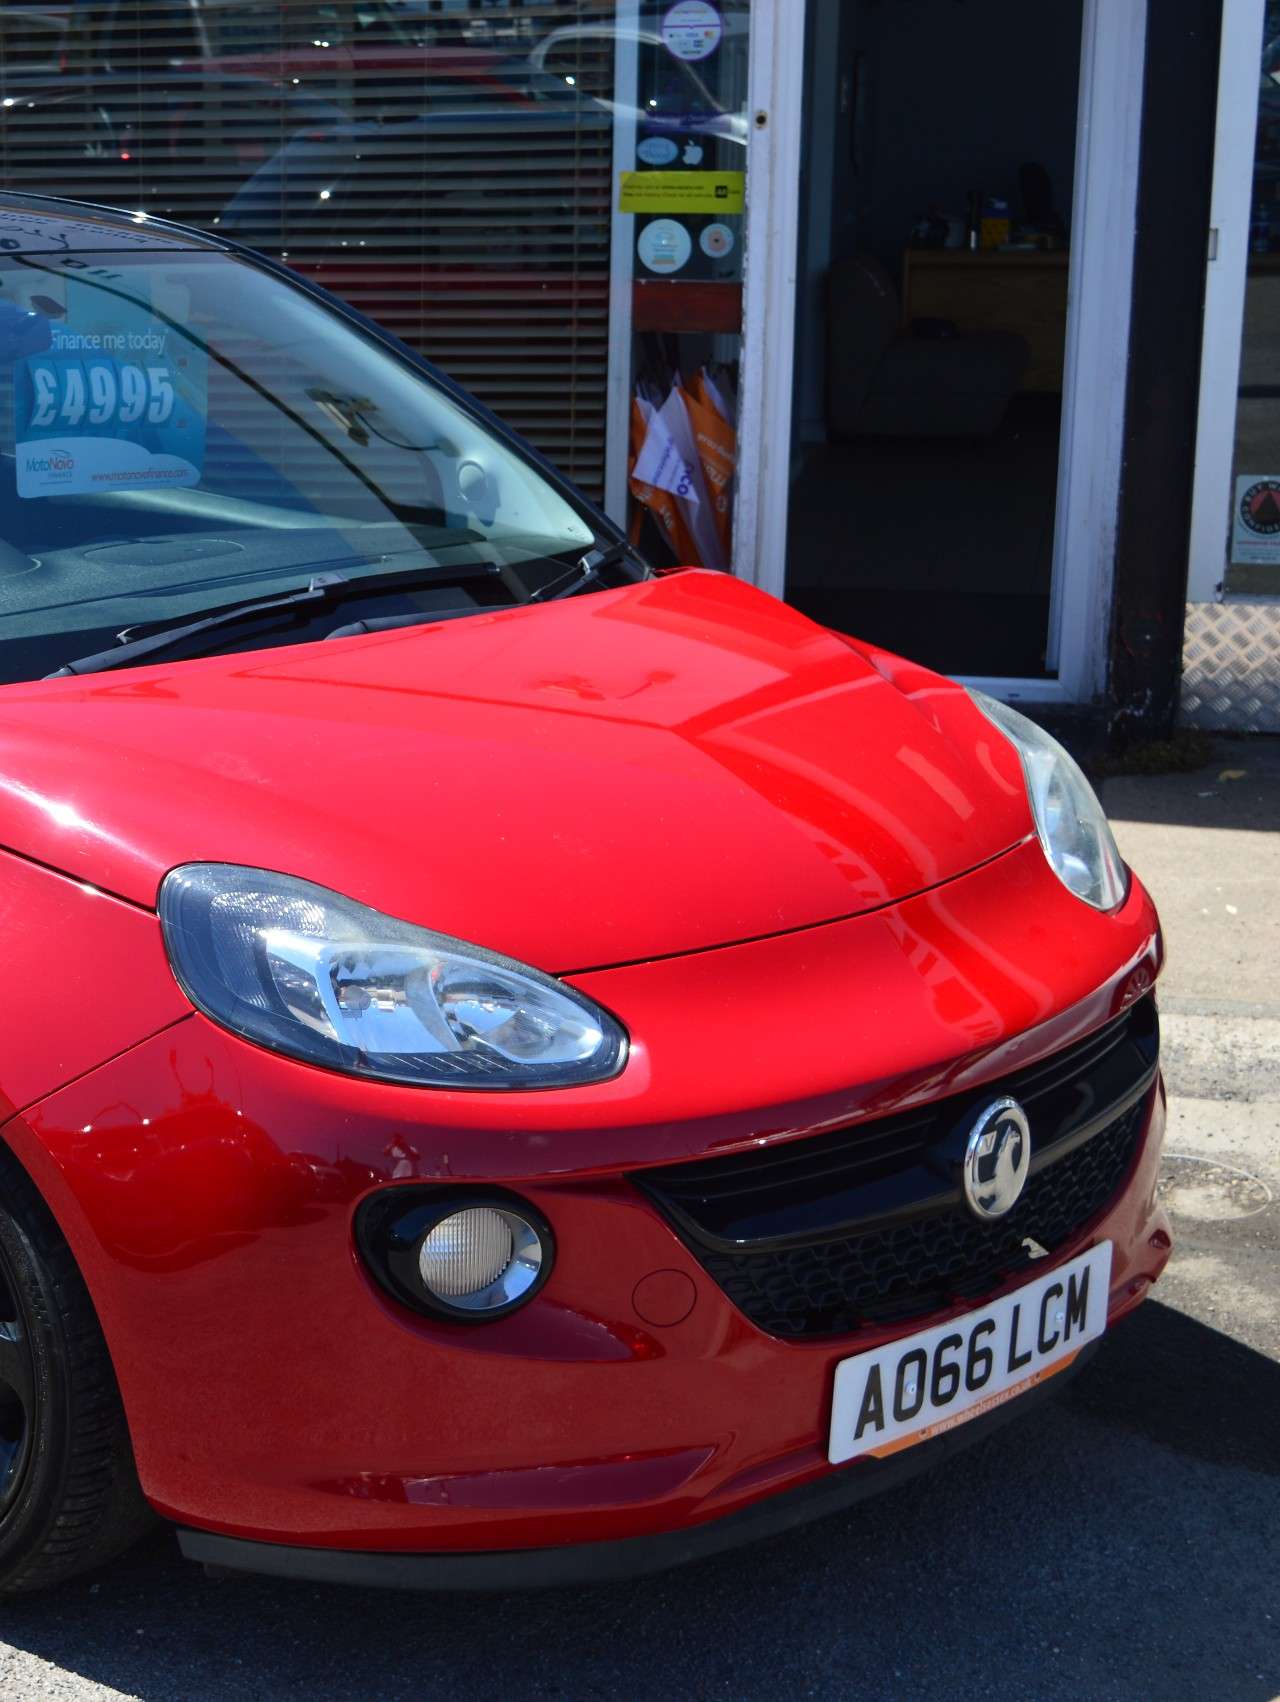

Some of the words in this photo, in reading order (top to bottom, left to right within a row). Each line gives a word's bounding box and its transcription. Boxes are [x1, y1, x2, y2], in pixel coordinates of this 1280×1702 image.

[50, 329, 101, 350] Finance
[103, 335, 125, 350] me
[31, 365, 175, 427] £4995
[853, 1317, 997, 1441] AO66
[1007, 1264, 1091, 1375] LCM
